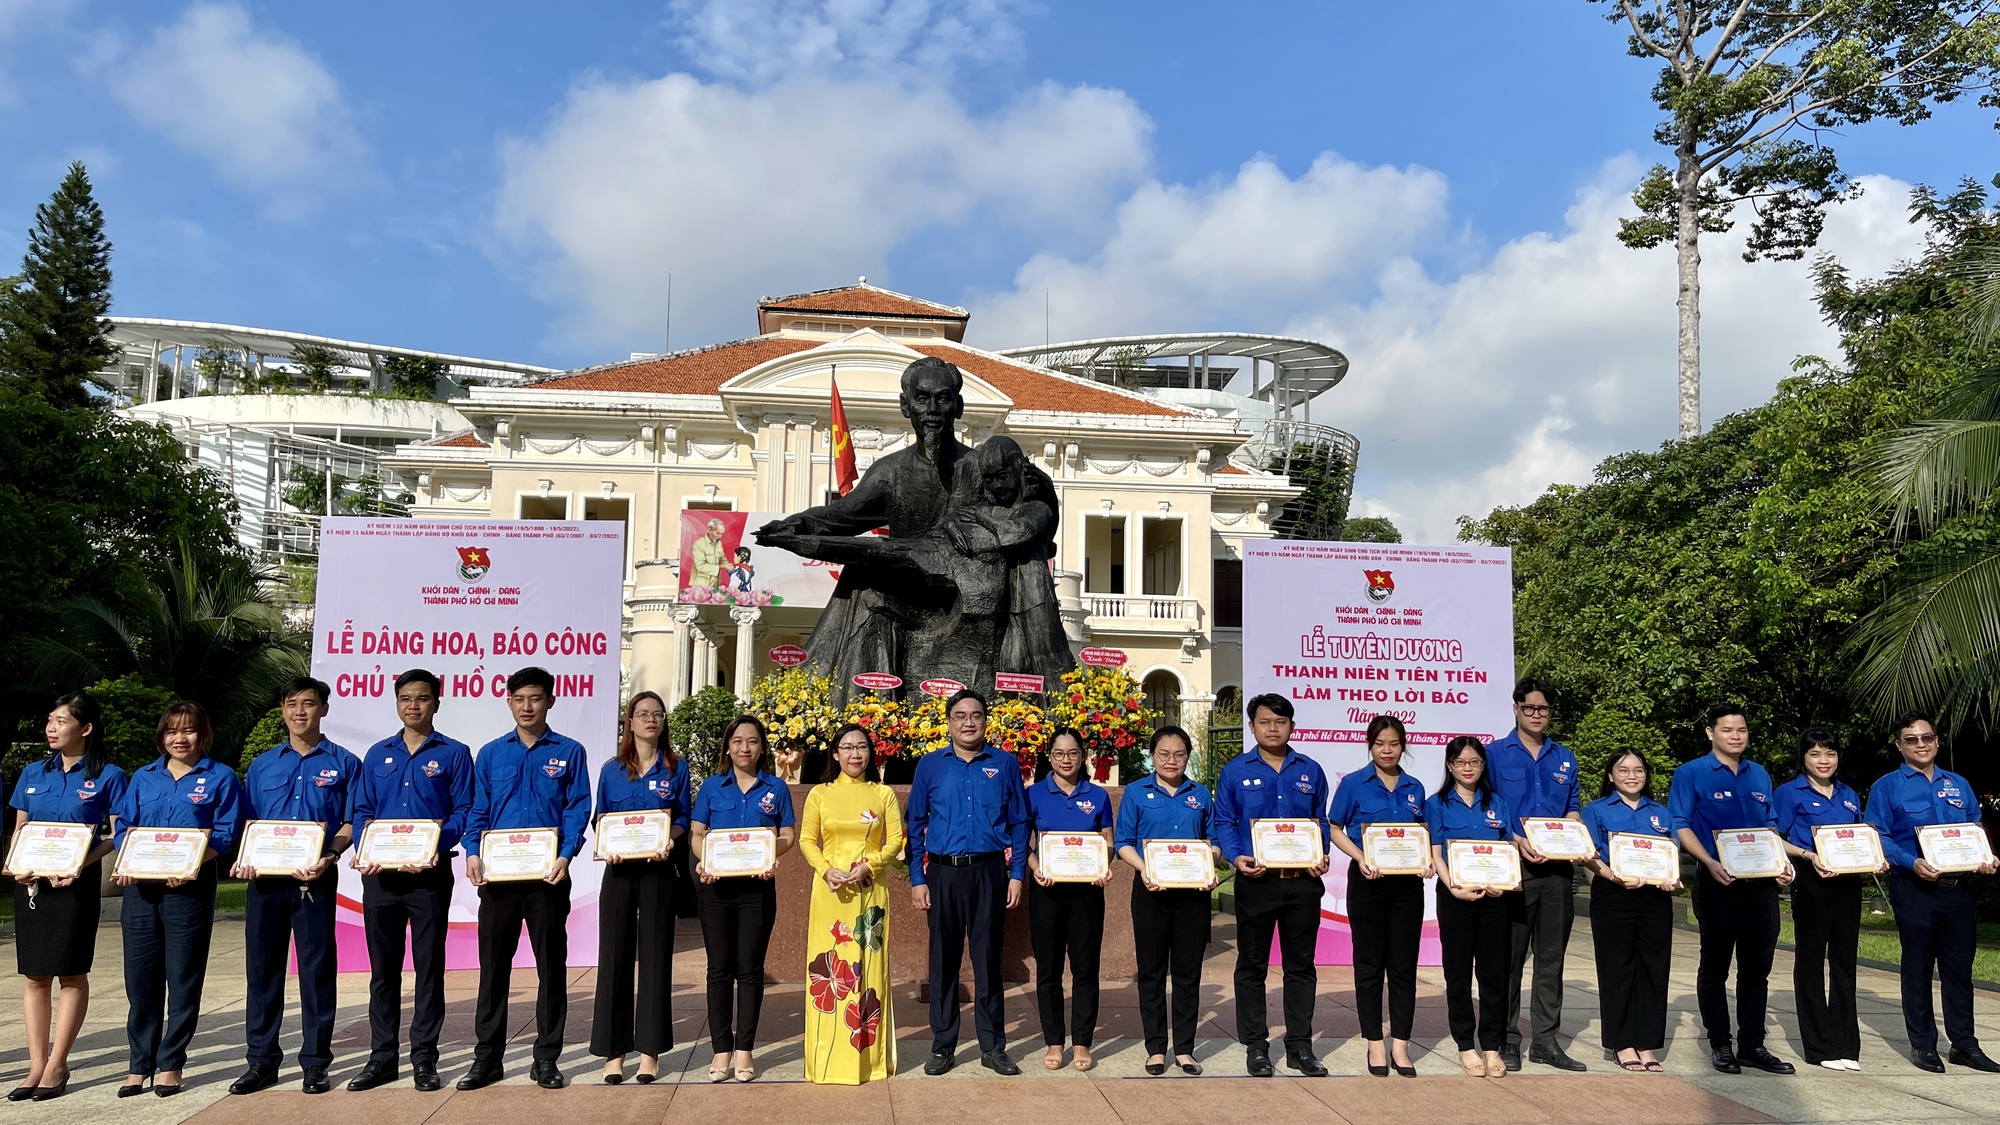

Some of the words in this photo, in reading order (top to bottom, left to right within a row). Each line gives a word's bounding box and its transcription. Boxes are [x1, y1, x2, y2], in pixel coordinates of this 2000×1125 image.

[422, 584, 441, 594] KHỐI
[443, 585, 459, 594] DÂN
[468, 585, 490, 595] CHÍNH
[498, 585, 521, 595] ĐẢNG
[423, 595, 449, 605] THÀNH
[451, 595, 468, 605] PHỐ
[484, 596, 496, 605] CHÍ
[498, 597, 519, 605] MINH
[1335, 604, 1352, 614] KHỐI
[1354, 606, 1369, 614] DÂN
[1376, 606, 1396, 615] CHÍNH
[1403, 607, 1423, 617] ĐẢNG
[1337, 615, 1360, 624] THÀNH
[1362, 615, 1377, 625] PHỐ
[1391, 617, 1402, 626] CHÍ
[1403, 618, 1422, 626] MINH
[327, 619, 355, 654] LỄ
[361, 625, 424, 655] DÂNG
[432, 632, 485, 660] HOA,
[492, 626, 538, 656] BÁO
[545, 626, 607, 656] CÔNG
[1301, 625, 1326, 658] LỄ
[1328, 631, 1391, 661] TUYÊN
[1394, 638, 1463, 663] DƯƠNG
[336, 664, 385, 698] CHỦ
[452, 665, 485, 698] HỒ
[554, 674, 594, 698] INH
[1272, 664, 1338, 679] THANH
[1344, 665, 1390, 681] NIÊN
[1395, 666, 1439, 683] TIÊN
[1444, 665, 1488, 684] TIẾN
[1292, 684, 1331, 701] LÀM
[1337, 688, 1388, 703] THEO
[1394, 687, 1425, 704] LỜI
[1431, 688, 1470, 705] BÁC
[1302, 730, 1320, 742] phố
[1320, 729, 1333, 741] Hồ
[1349, 732, 1368, 741] Min
[1412, 733, 1439, 745] tháng
[1440, 734, 1447, 744] 5
